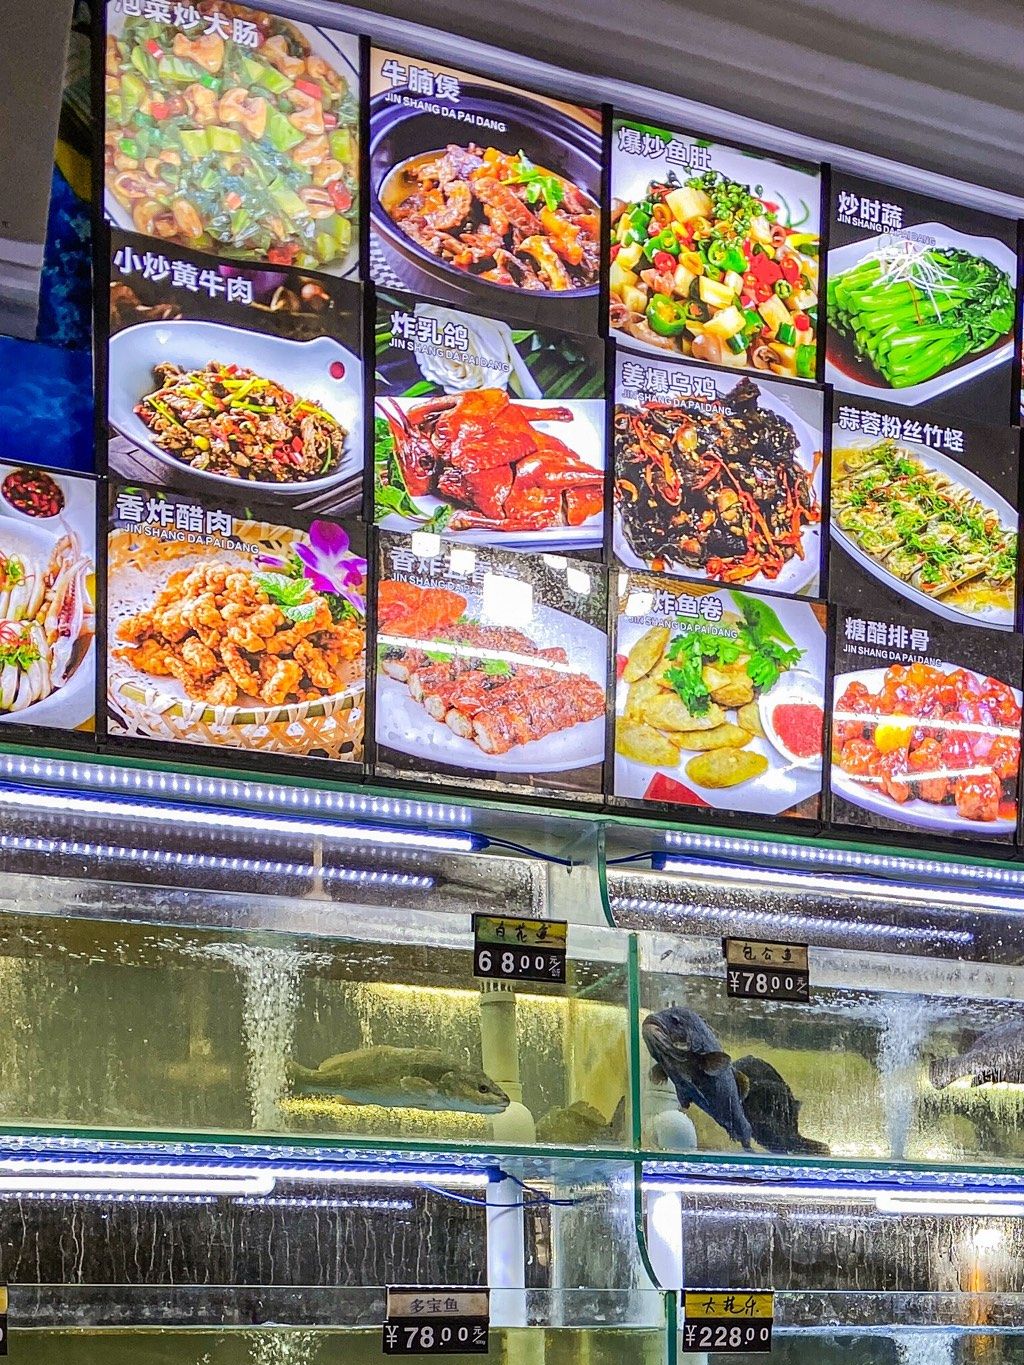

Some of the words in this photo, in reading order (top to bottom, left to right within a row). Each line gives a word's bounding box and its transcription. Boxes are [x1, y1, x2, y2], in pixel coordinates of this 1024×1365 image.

[381, 59, 461, 103] 牛腩煲
[385, 93, 401, 104] JIN
[403, 97, 440, 115] SHANG
[442, 106, 456, 119] DA
[458, 111, 474, 124] PAI
[476, 117, 507, 132] DANG
[618, 126, 711, 171] 爆炒鱼肚
[837, 214, 850, 223] JIN
[852, 217, 882, 232] SHANG
[838, 190, 903, 228] 炒时蔬
[114, 246, 253, 304] 小炒黄牛肉
[390, 310, 469, 351] 炸乳鸽
[389, 337, 405, 349] JIN
[407, 341, 443, 357] SHANG
[446, 350, 461, 361] DA
[462, 354, 479, 365] PAI
[480, 357, 510, 372] DANG
[622, 361, 717, 400] 姜爆乌鸡
[637, 392, 672, 405] SHANG
[673, 398, 686, 408] DA
[688, 401, 704, 412] PAI
[705, 403, 732, 416] DANG
[838, 406, 964, 453] 蒜蓉粉丝竹蛏
[116, 493, 233, 537] 香炸醋肉
[124, 523, 142, 534] JIN
[145, 526, 185, 542] SHANG
[188, 533, 204, 545] DA
[206, 536, 225, 548] PAI
[226, 540, 259, 554] DANG
[391, 572, 407, 582] JIN
[409, 575, 445, 588] SHANG
[680, 622, 693, 631] DA
[694, 624, 710, 634] PAI
[711, 626, 738, 638] DANG
[844, 617, 930, 652] 糖醋排骨
[843, 643, 857, 654] JIN
[858, 646, 888, 658] SHANG
[889, 651, 901, 661] DA
[902, 654, 917, 663] PAI
[918, 655, 942, 667] DANG
[729, 971, 793, 993] ¥78.00
[410, 1298, 459, 1313] 多宝鱼
[385, 1325, 468, 1348] ¥78.00
[685, 1325, 769, 1347] ¥228.00
